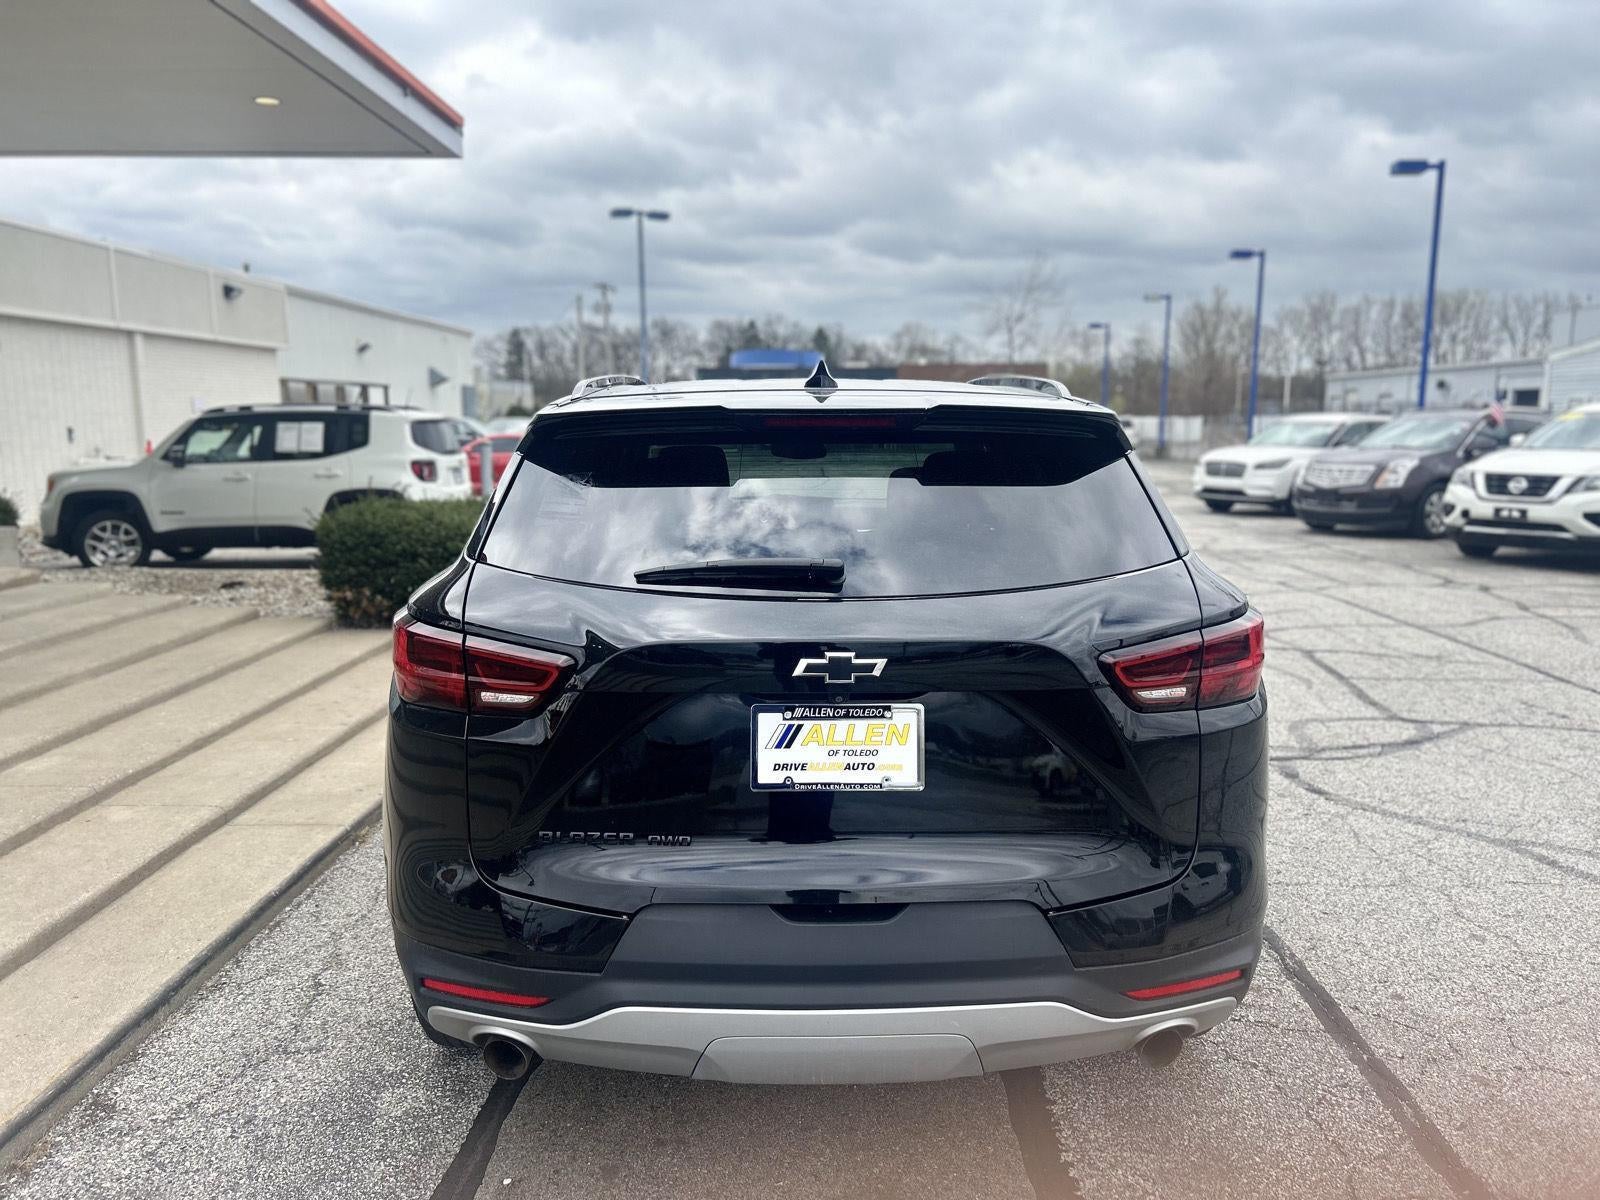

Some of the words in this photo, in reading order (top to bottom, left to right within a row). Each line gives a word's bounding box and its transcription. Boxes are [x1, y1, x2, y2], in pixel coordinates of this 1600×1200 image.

[803, 707, 834, 717] ALLEN
[835, 708, 847, 717] OF
[848, 708, 883, 717] TOLEDO
[801, 723, 911, 746] ALLEN
[827, 749, 840, 757] OF
[842, 749, 879, 757] TOLEDO
[538, 831, 635, 844] BLAZER
[647, 835, 692, 846] AWD
